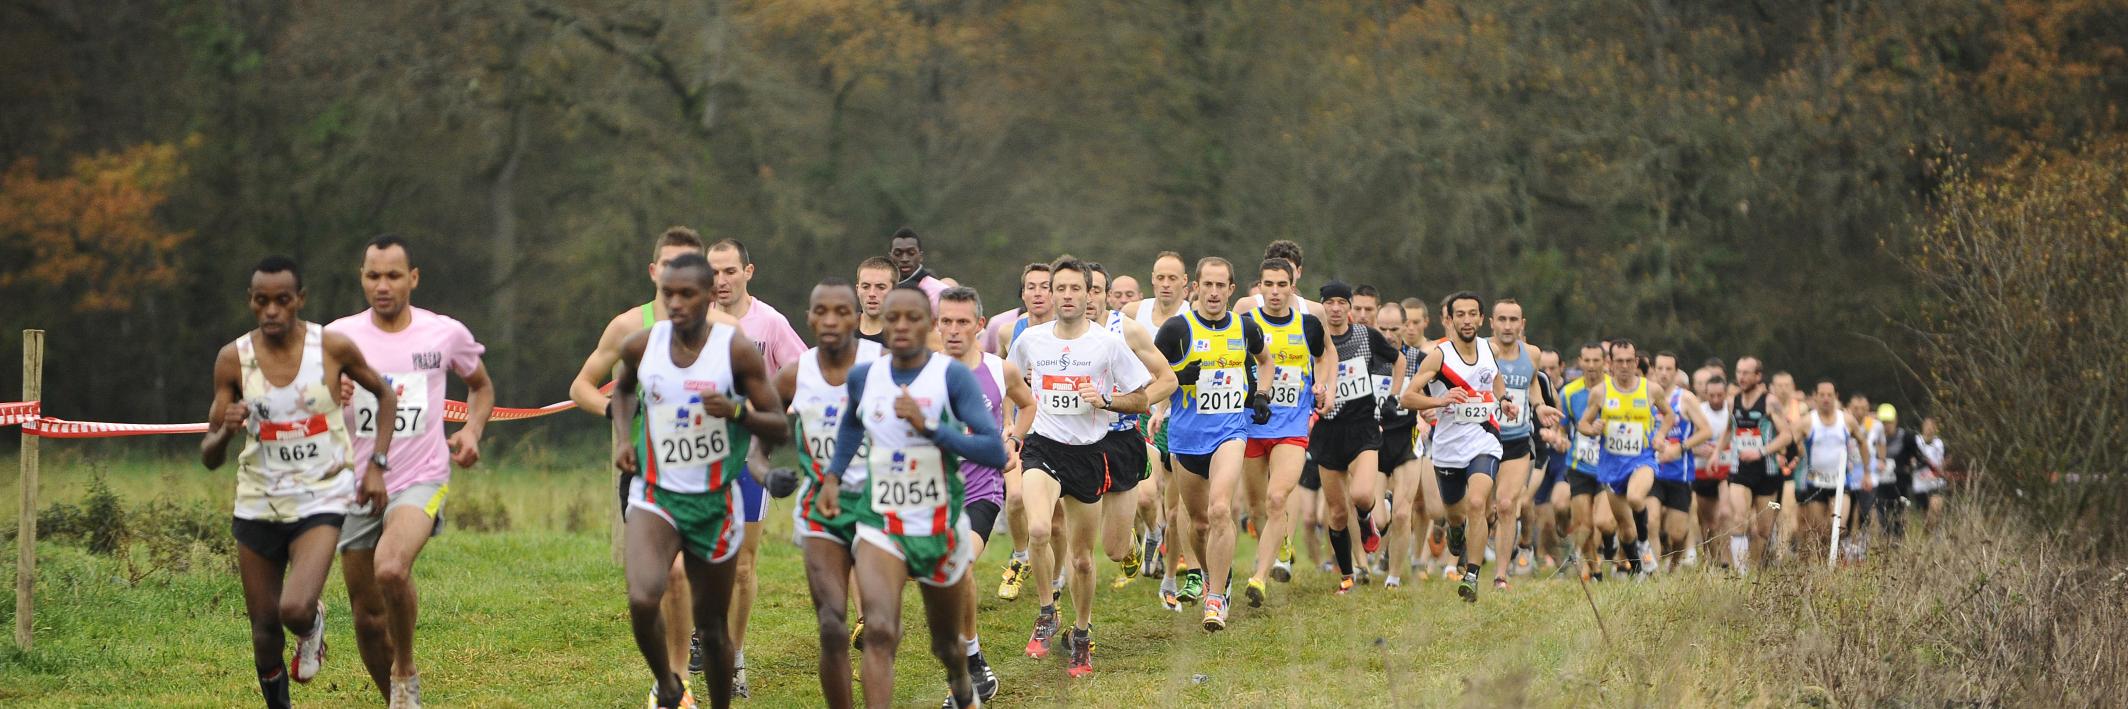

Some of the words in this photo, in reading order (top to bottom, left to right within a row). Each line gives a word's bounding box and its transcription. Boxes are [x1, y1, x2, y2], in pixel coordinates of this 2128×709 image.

[1036, 359, 1058, 367] SOBHI
[1072, 359, 1092, 367] Sport
[1052, 395, 1079, 409] 591
[1200, 391, 1242, 411] 2012
[359, 405, 422, 433] 257
[1465, 407, 1487, 418] 623
[280, 442, 319, 462] 662
[663, 430, 724, 463] 2056
[1609, 436, 1639, 452] 2044
[877, 478, 940, 506] 2054
